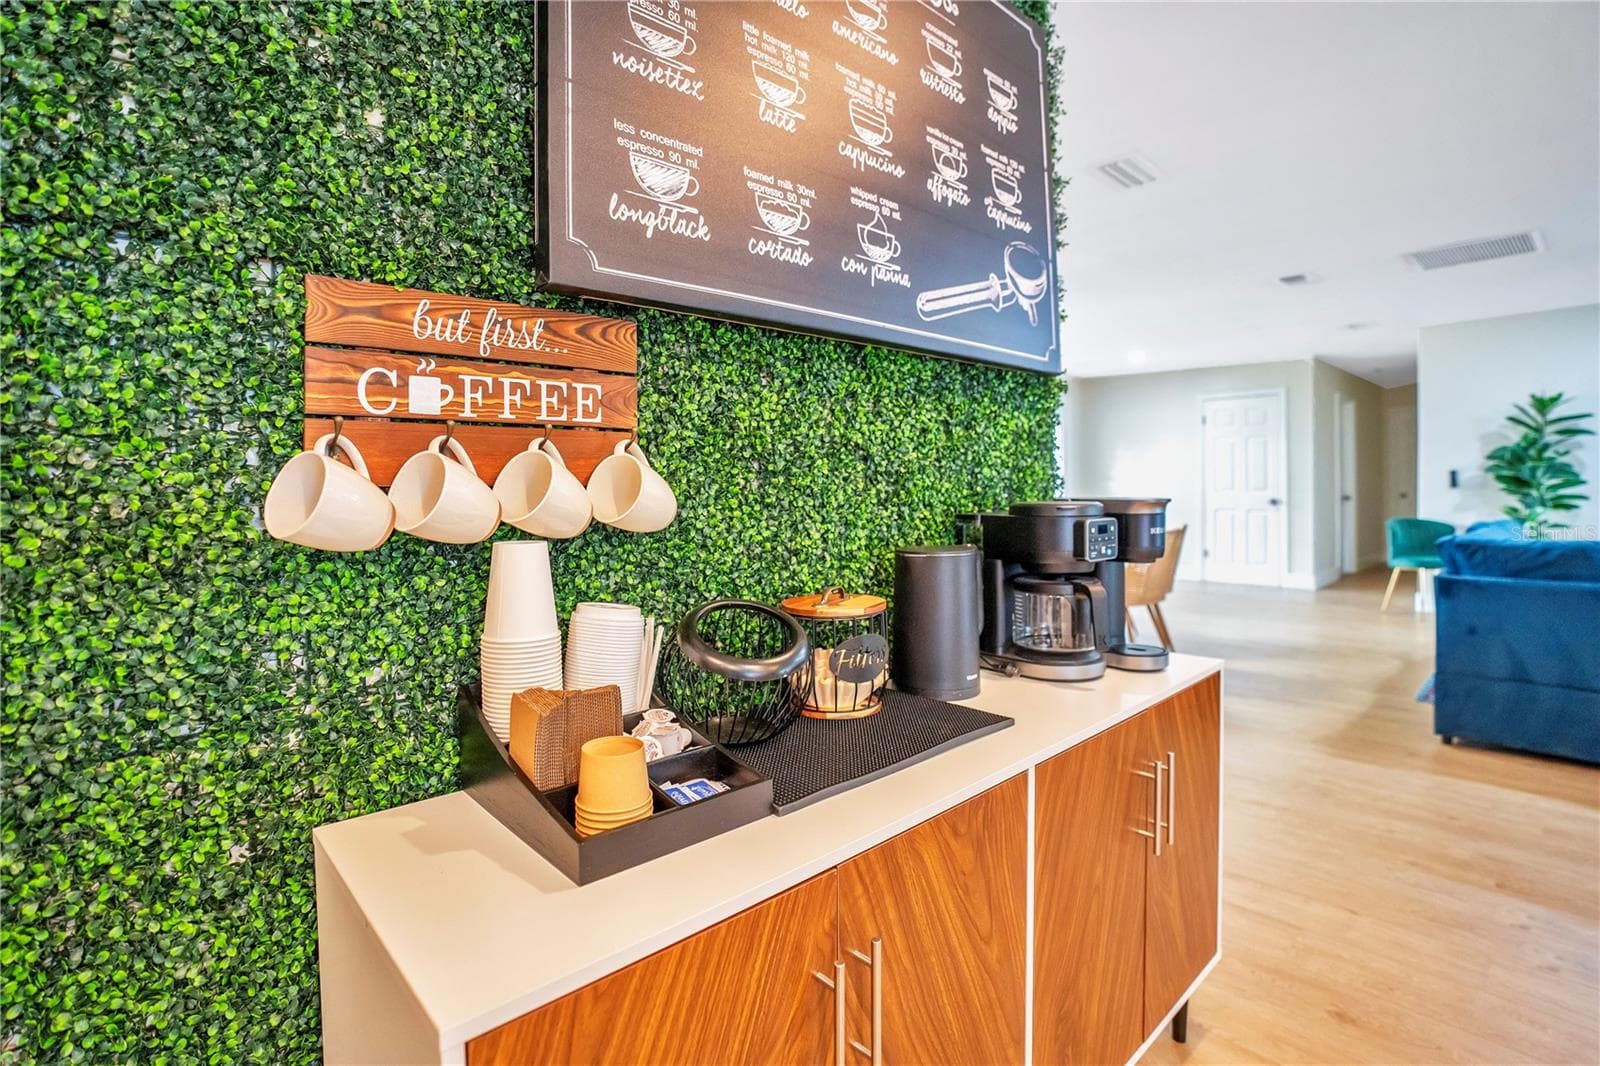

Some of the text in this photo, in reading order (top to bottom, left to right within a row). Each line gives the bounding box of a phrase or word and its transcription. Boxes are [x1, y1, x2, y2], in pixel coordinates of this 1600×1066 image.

[668, 10, 681, 24] 60
[685, 19, 699, 33] ml.
[685, 7, 698, 20] ml.
[742, 20, 810, 62] little foamed milk
[745, 32, 758, 46] hot
[762, 42, 777, 54] milk
[782, 51, 796, 65] 120
[747, 46, 784, 69] espresso
[832, 20, 899, 66] americano
[759, 99, 797, 134] latte
[613, 117, 704, 158] less concentrated
[617, 136, 700, 170] espresso 90 ml.
[838, 141, 906, 179] cappucino
[743, 165, 774, 185] foamed
[777, 179, 793, 191] milk
[747, 181, 784, 200] espresso
[850, 186, 899, 210] whipped cream
[850, 197, 880, 212] espresso
[748, 237, 814, 267] cortado
[841, 256, 911, 289] con panna
[412, 299, 473, 342] but
